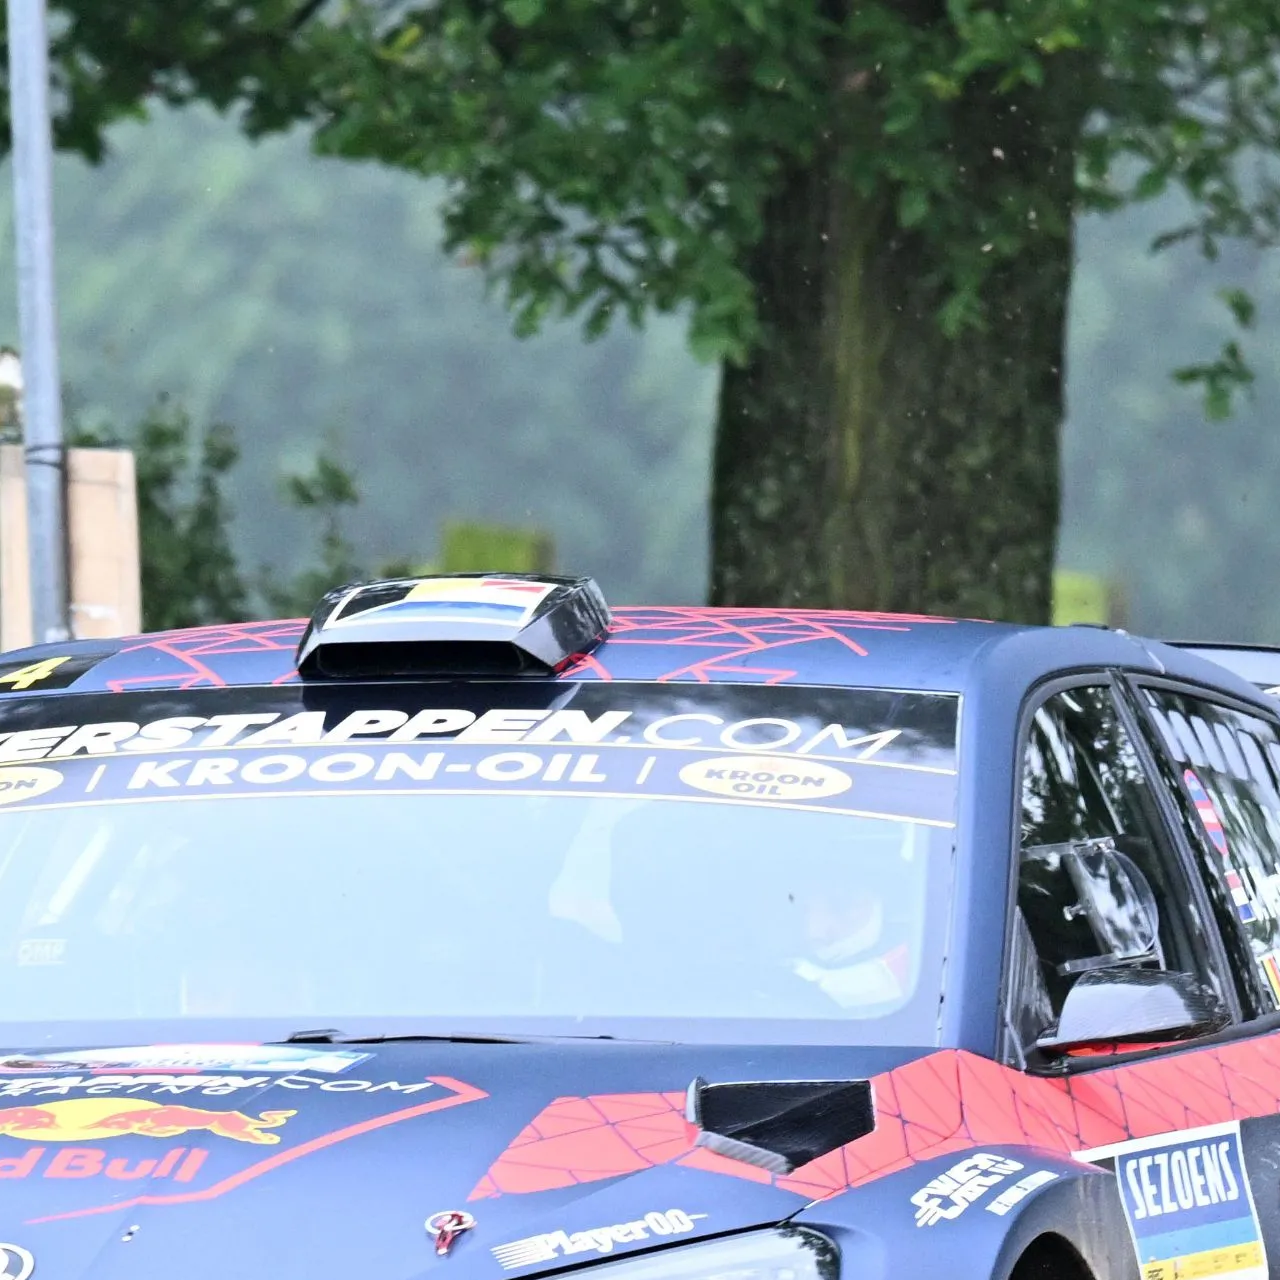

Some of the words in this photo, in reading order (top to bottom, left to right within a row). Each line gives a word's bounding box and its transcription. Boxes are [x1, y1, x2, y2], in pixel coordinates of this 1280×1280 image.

[127, 752, 607, 791] KROON-OIL
[705, 767, 825, 788] KROON
[732, 782, 782, 797] OIL
[42, 1148, 210, 1183] Bull
[1125, 1141, 1241, 1221] SEZOENS
